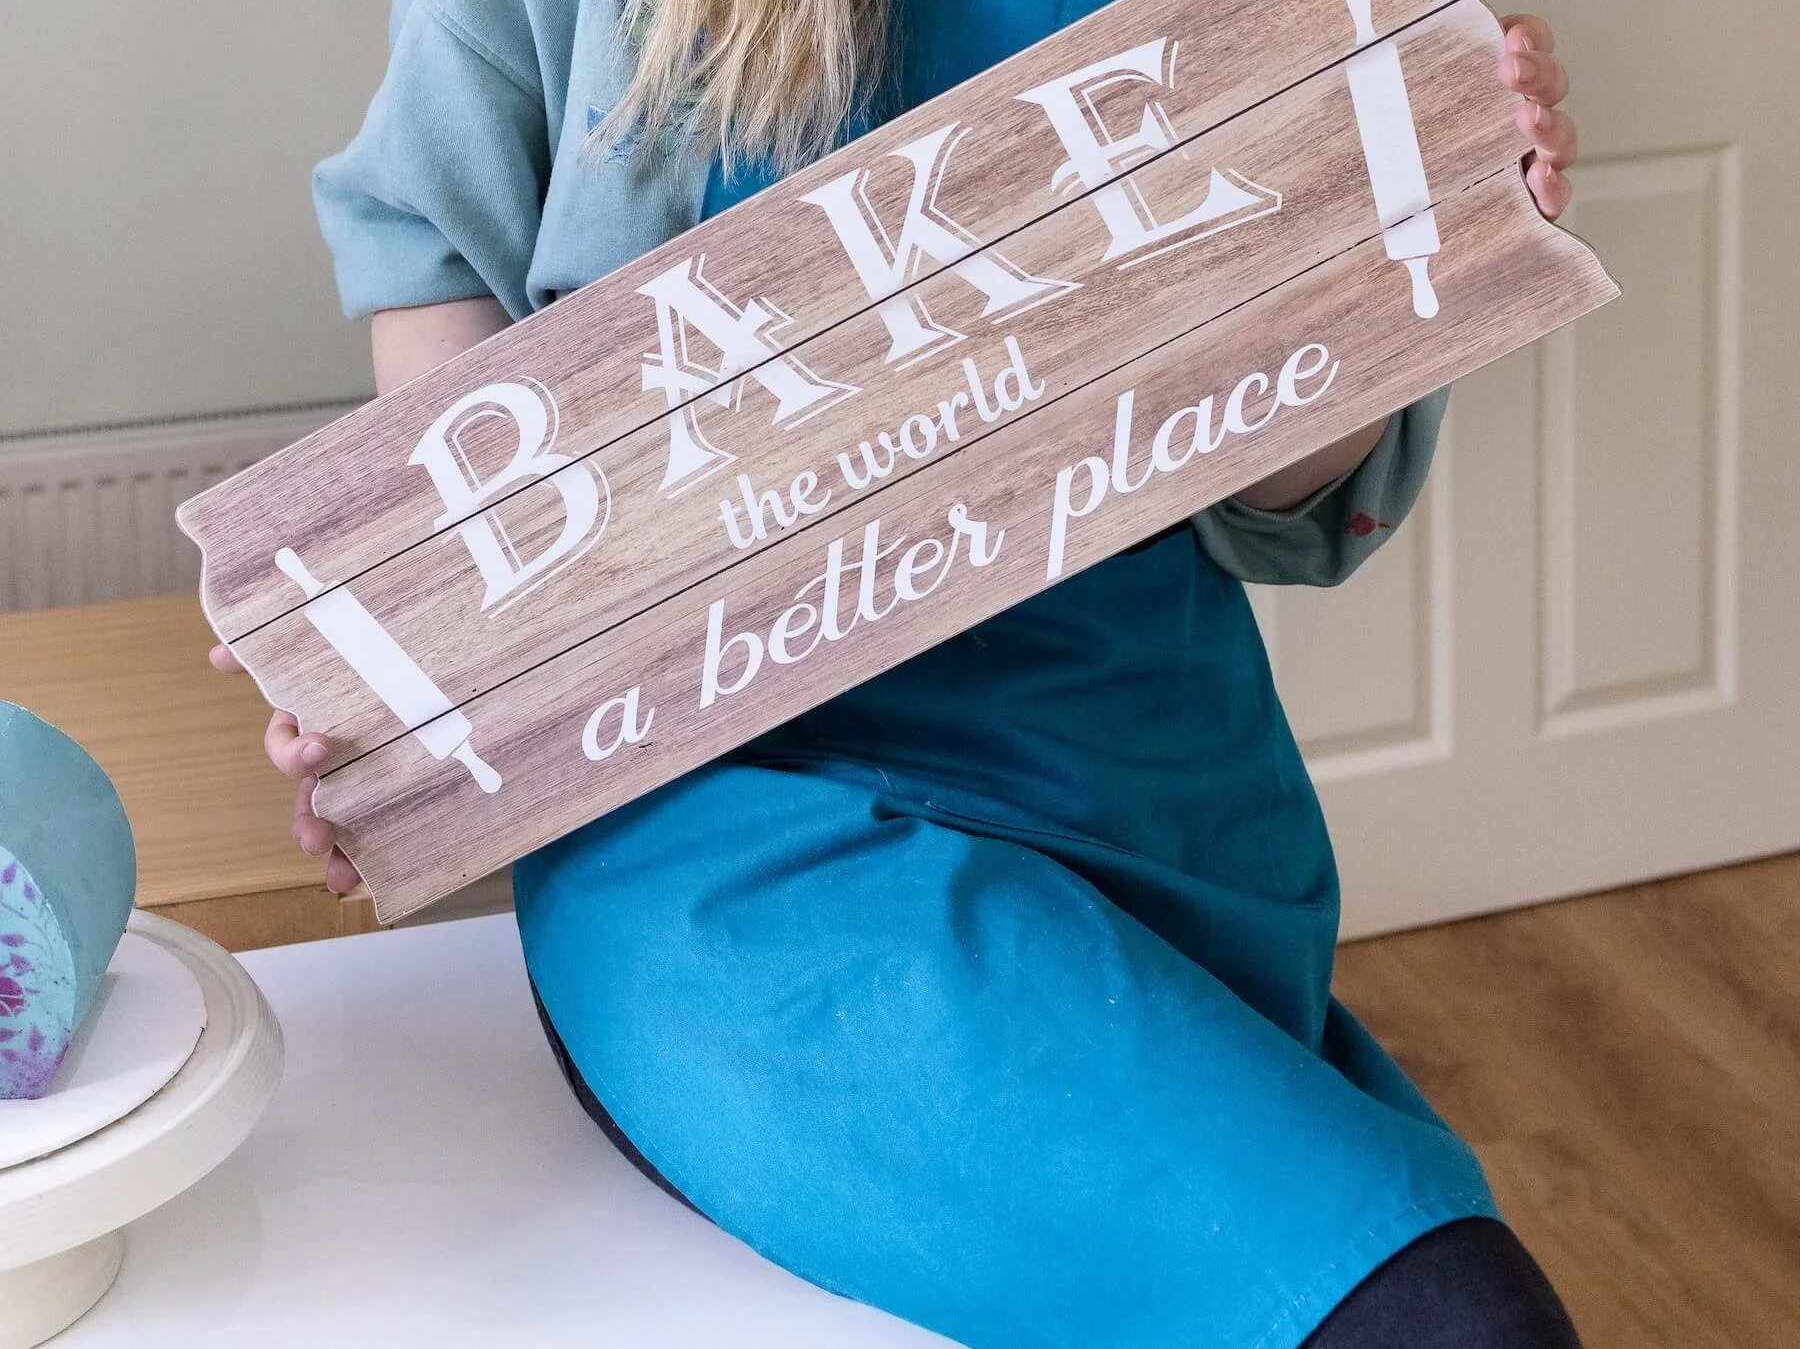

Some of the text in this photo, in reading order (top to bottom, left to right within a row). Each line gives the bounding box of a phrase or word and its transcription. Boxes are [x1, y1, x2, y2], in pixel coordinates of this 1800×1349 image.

[407, 35, 1284, 619] BAKE
[717, 335, 1045, 550] the world
[580, 341, 1341, 761] a better place
